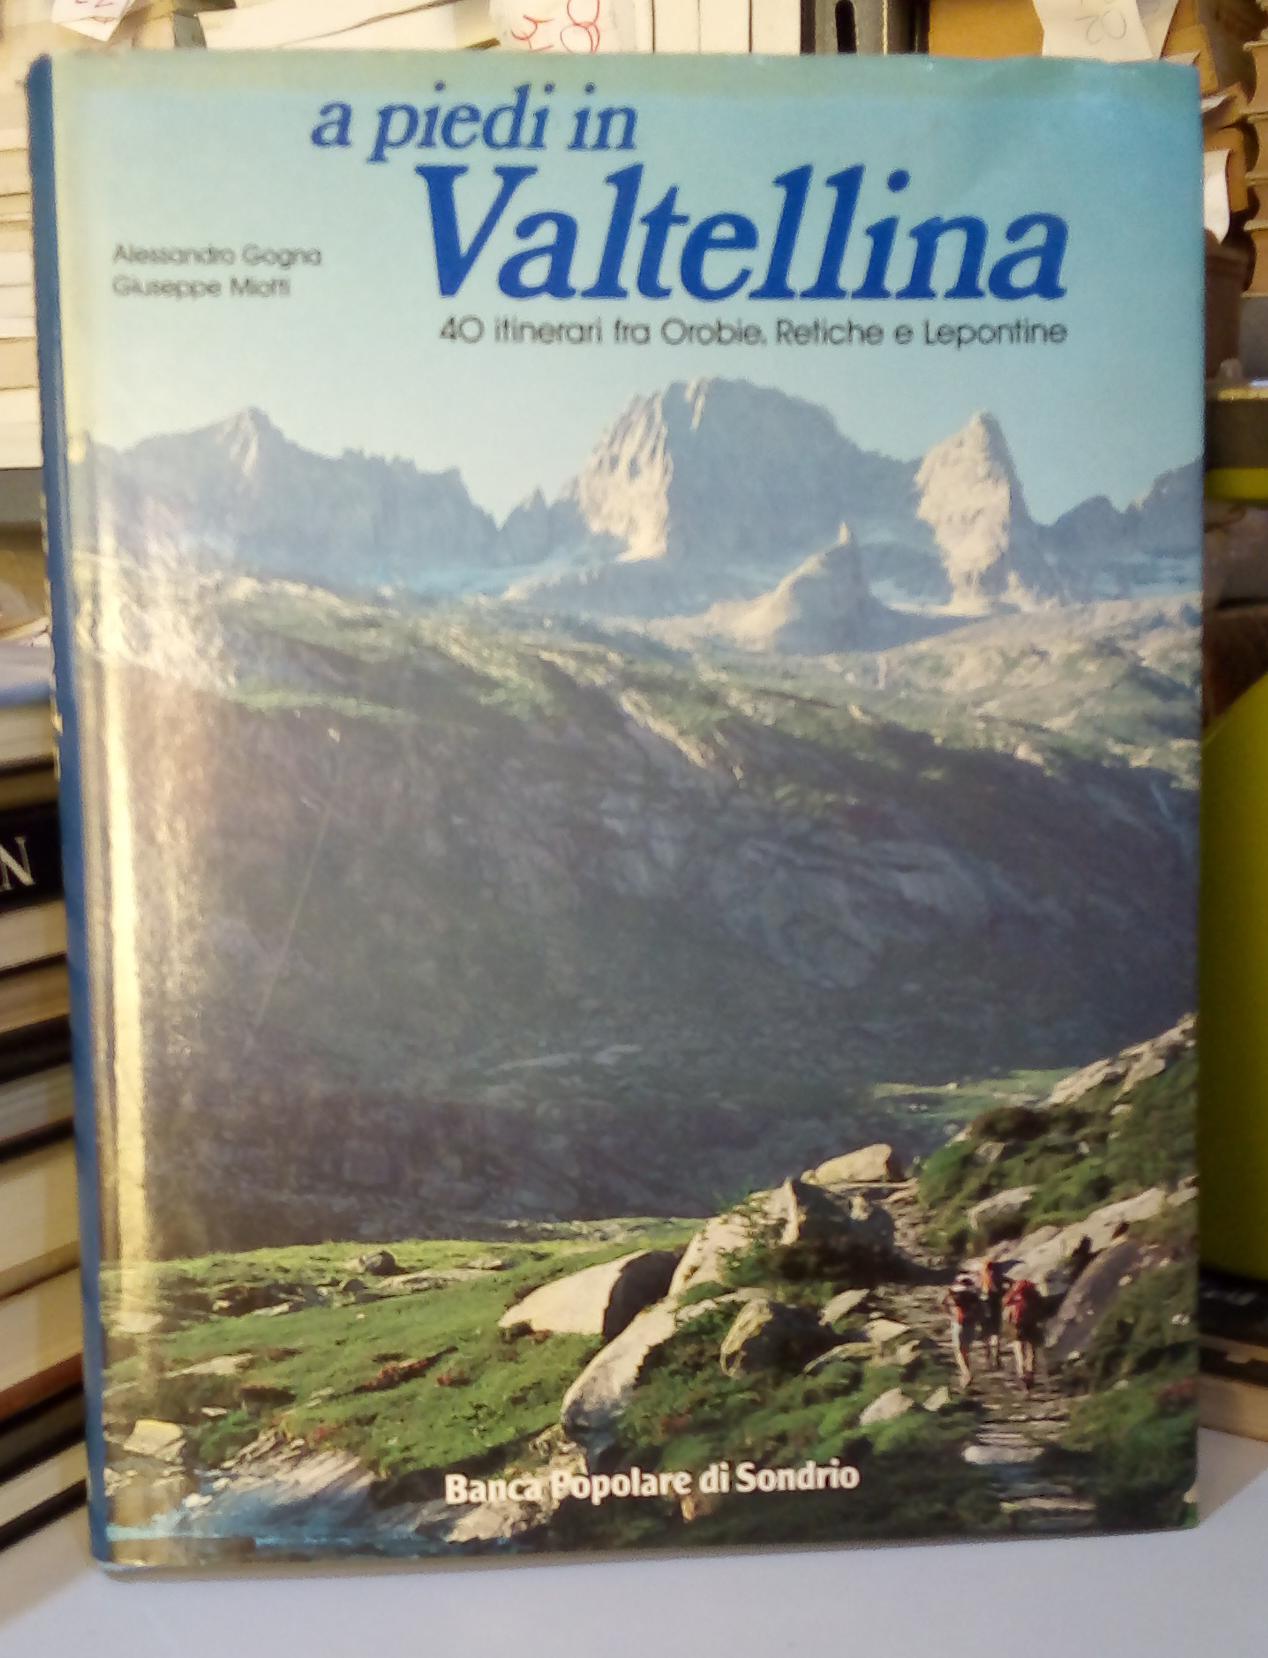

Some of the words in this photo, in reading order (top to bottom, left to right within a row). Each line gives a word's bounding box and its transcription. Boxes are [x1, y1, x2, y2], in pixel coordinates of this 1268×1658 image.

[310, 101, 353, 148] a
[367, 81, 556, 162] piedi
[567, 82, 639, 150] in
[415, 163, 1070, 300] Valtellina
[113, 244, 235, 265] Alessandro
[244, 243, 321, 269] Gogna
[113, 275, 221, 299] Giuseppe
[231, 275, 291, 297] Miotti
[439, 317, 483, 345] 40
[495, 316, 603, 344] itinerari
[614, 316, 652, 345] fra
[776, 318, 884, 346] Retiche
[894, 325, 914, 346] e
[924, 319, 1069, 350] Lepontine
[445, 1473, 542, 1504] Banca
[552, 1466, 691, 1505] Popolare
[701, 1463, 731, 1493] di
[736, 1457, 860, 1493] Sondrio
